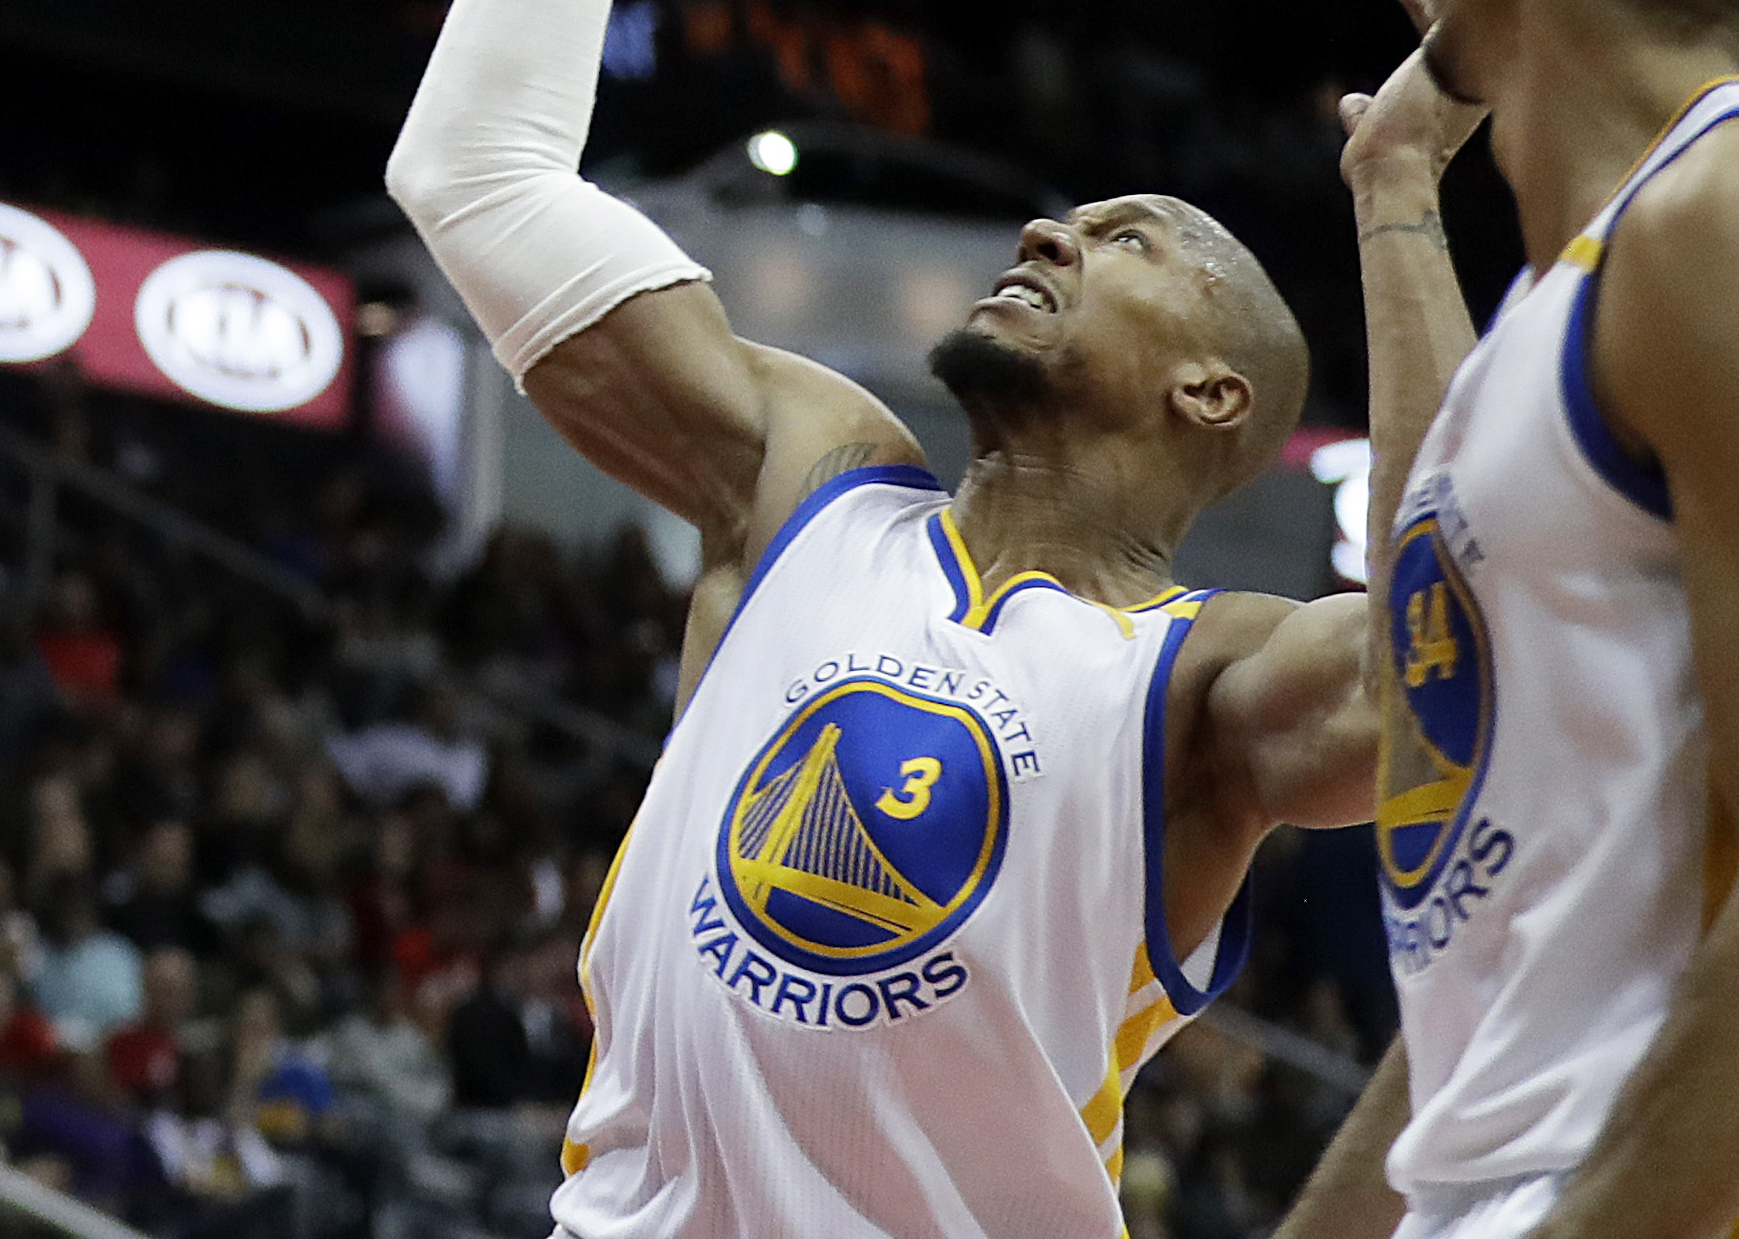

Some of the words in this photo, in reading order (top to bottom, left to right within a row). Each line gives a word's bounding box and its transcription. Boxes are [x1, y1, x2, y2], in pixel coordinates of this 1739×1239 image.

[785, 652, 965, 706] GOLDEN
[967, 681, 1043, 778] STATE
[875, 756, 942, 820] 3
[691, 873, 969, 1027] WARRIORS
